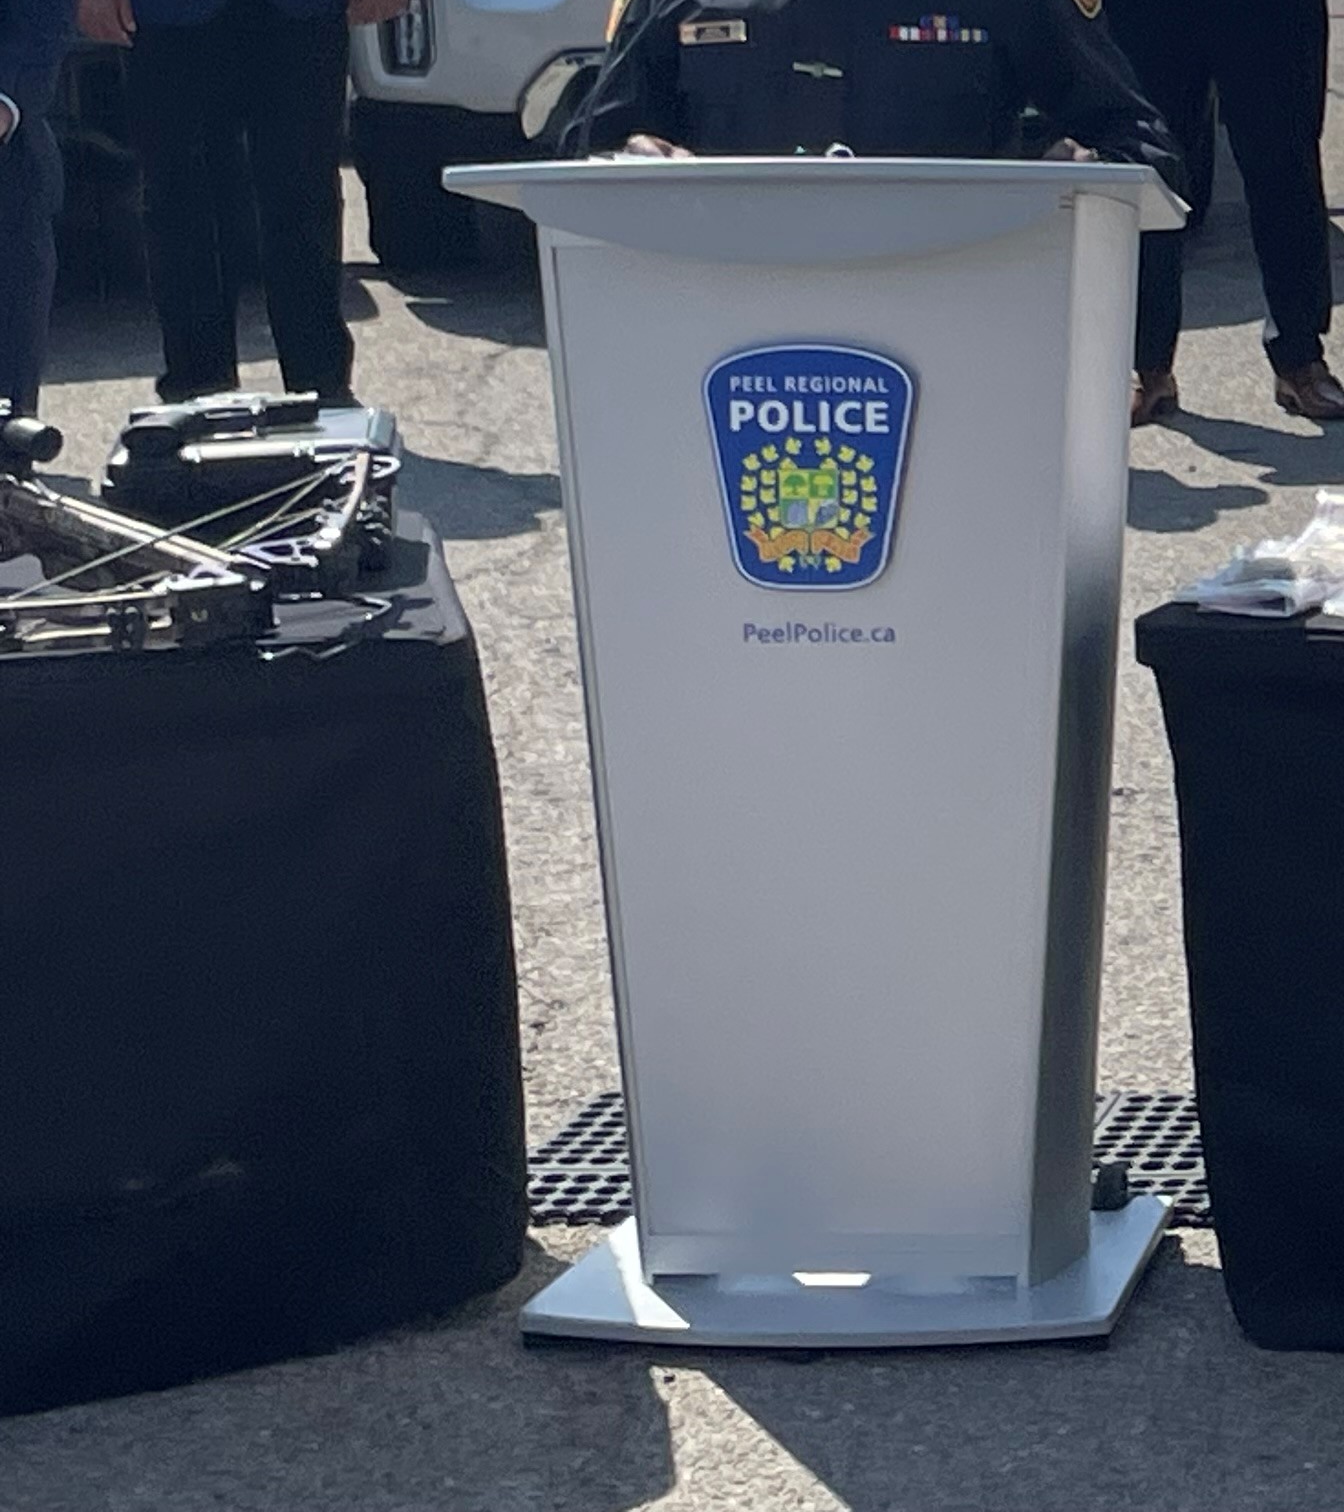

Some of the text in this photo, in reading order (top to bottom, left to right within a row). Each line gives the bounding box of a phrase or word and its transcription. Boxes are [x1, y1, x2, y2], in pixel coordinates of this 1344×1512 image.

[729, 376, 889, 393] PEEL REGIONAL
[729, 399, 889, 433] POLICE
[743, 621, 895, 644] PeelPolice.ca
